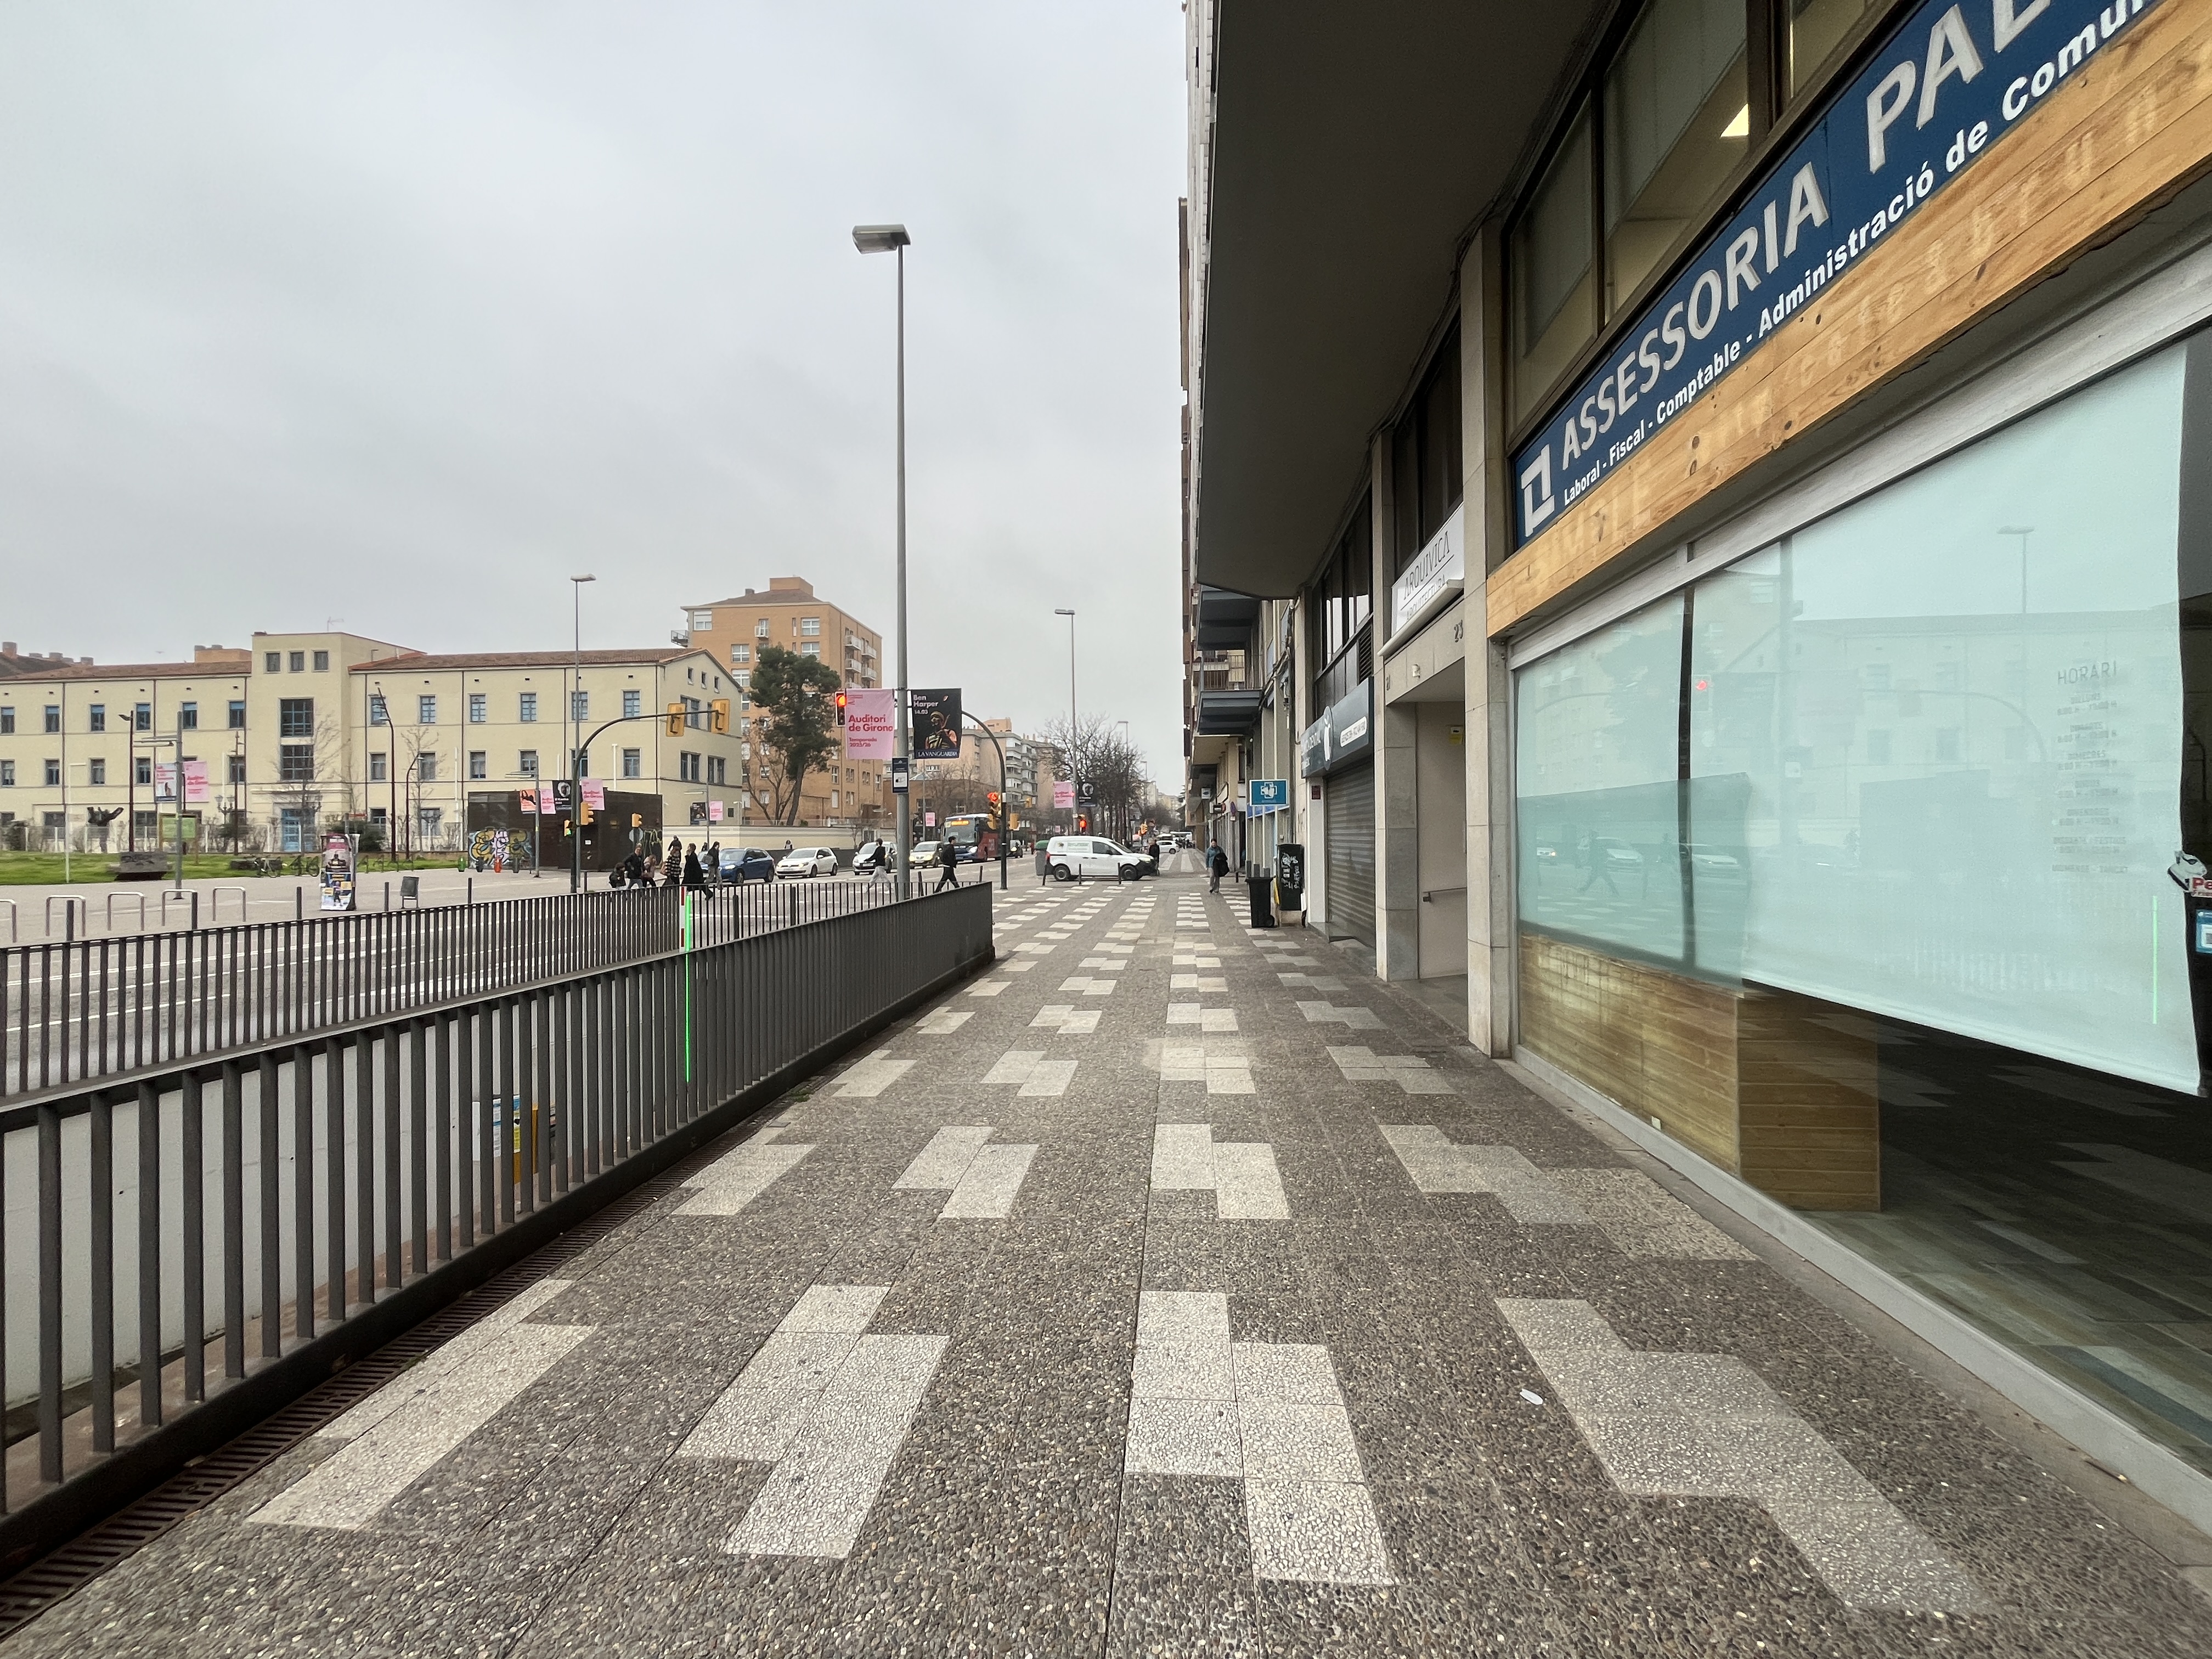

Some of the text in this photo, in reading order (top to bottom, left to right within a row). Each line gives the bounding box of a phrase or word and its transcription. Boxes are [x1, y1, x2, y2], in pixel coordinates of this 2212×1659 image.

[1562, 161, 1829, 471] ASSESSORIA
[1564, 459, 1600, 506] Laboral
[1609, 419, 1645, 467] Fiscal
[1656, 341, 1741, 425] Comptable
[1758, 160, 1934, 338] Administració
[1945, 120, 1989, 173] de
[1454, 619, 1464, 642] 23
[2057, 661, 2117, 685] HORARI
[913, 701, 939, 709] Harper
[848, 714, 886, 723] Auditori
[848, 723, 893, 732] de Girona
